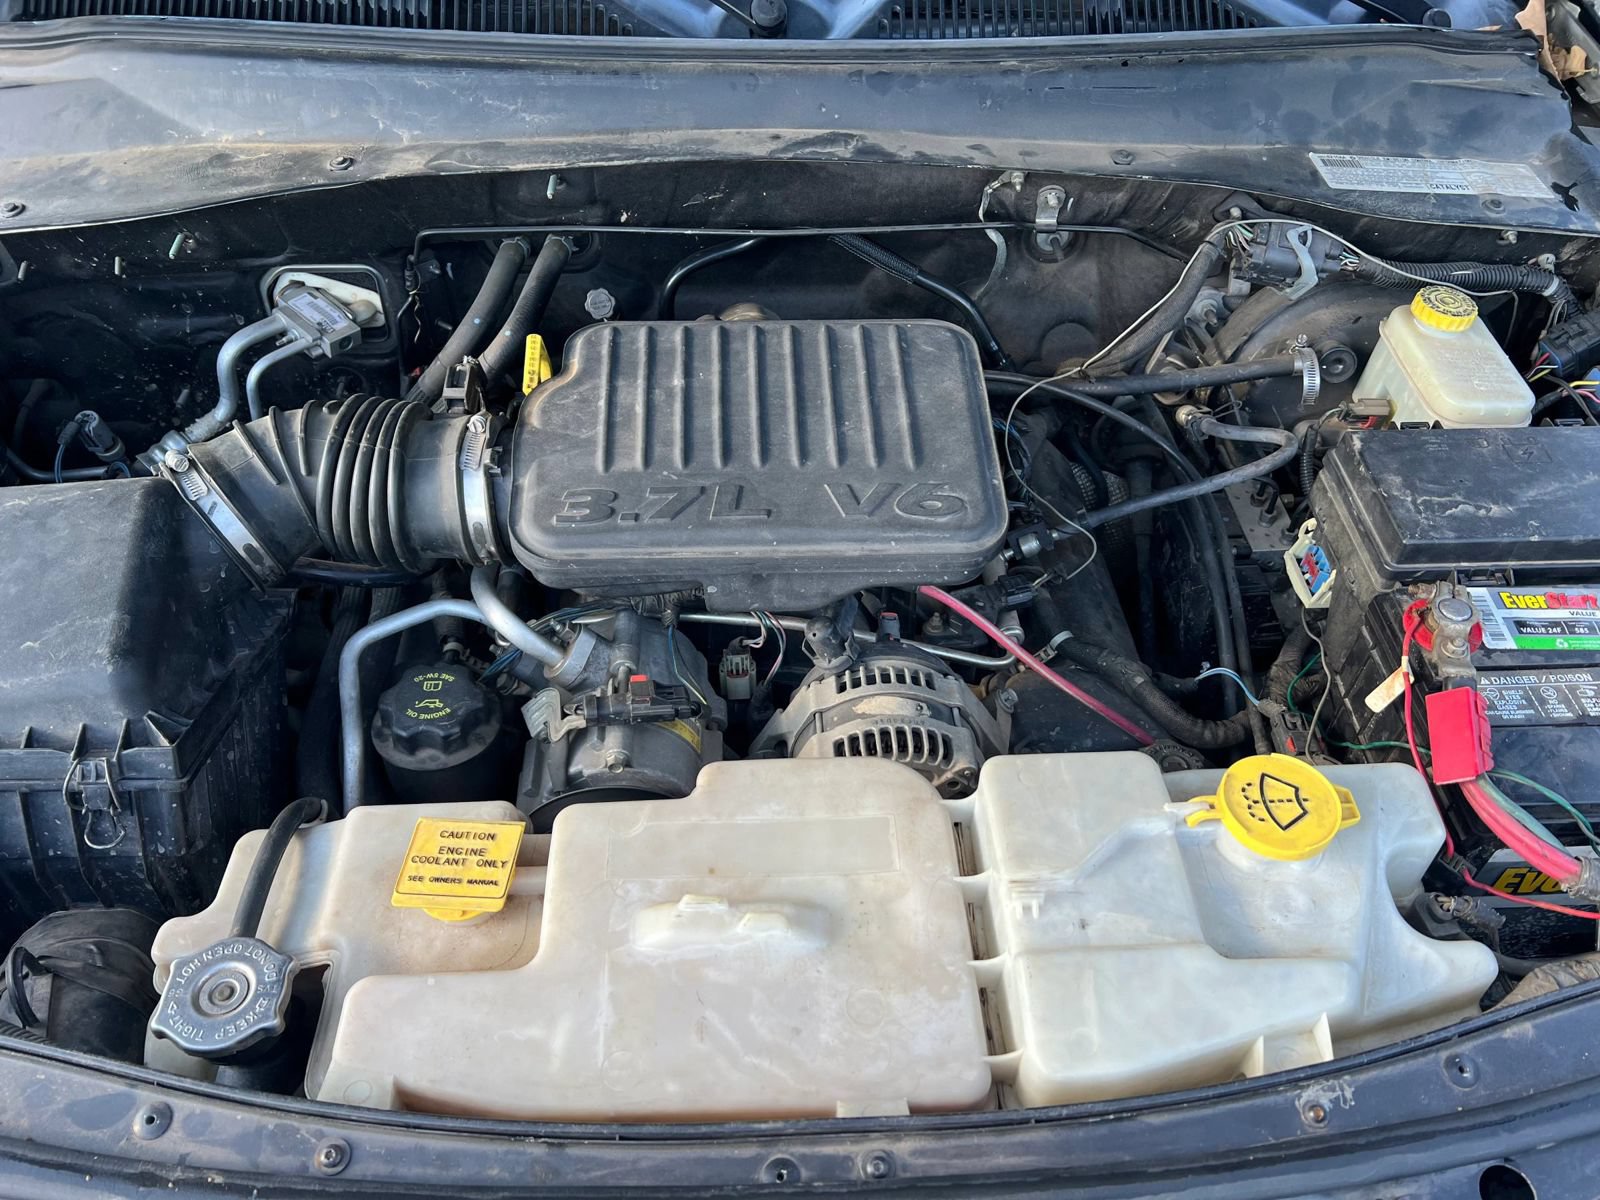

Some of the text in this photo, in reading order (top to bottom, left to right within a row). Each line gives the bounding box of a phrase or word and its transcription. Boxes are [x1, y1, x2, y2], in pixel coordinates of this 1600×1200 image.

[554, 480, 971, 527] 3.7L V6
[440, 672, 455, 682] SAE
[1490, 675, 1539, 685] DANGER
[1549, 673, 1594, 682] POISON
[405, 707, 451, 720] ENGINE OIL
[439, 830, 496, 841] CAUTION
[438, 846, 487, 857] ENGINE
[410, 855, 509, 869] COOLANT ONLY
[428, 876, 462, 884] OWNERS
[466, 878, 499, 886] MANUAL
[202, 943, 243, 962] OPEN
[244, 945, 269, 965] NOT
[176, 958, 201, 985] HOT
[168, 1011, 259, 1042] KEEP TIGHT
